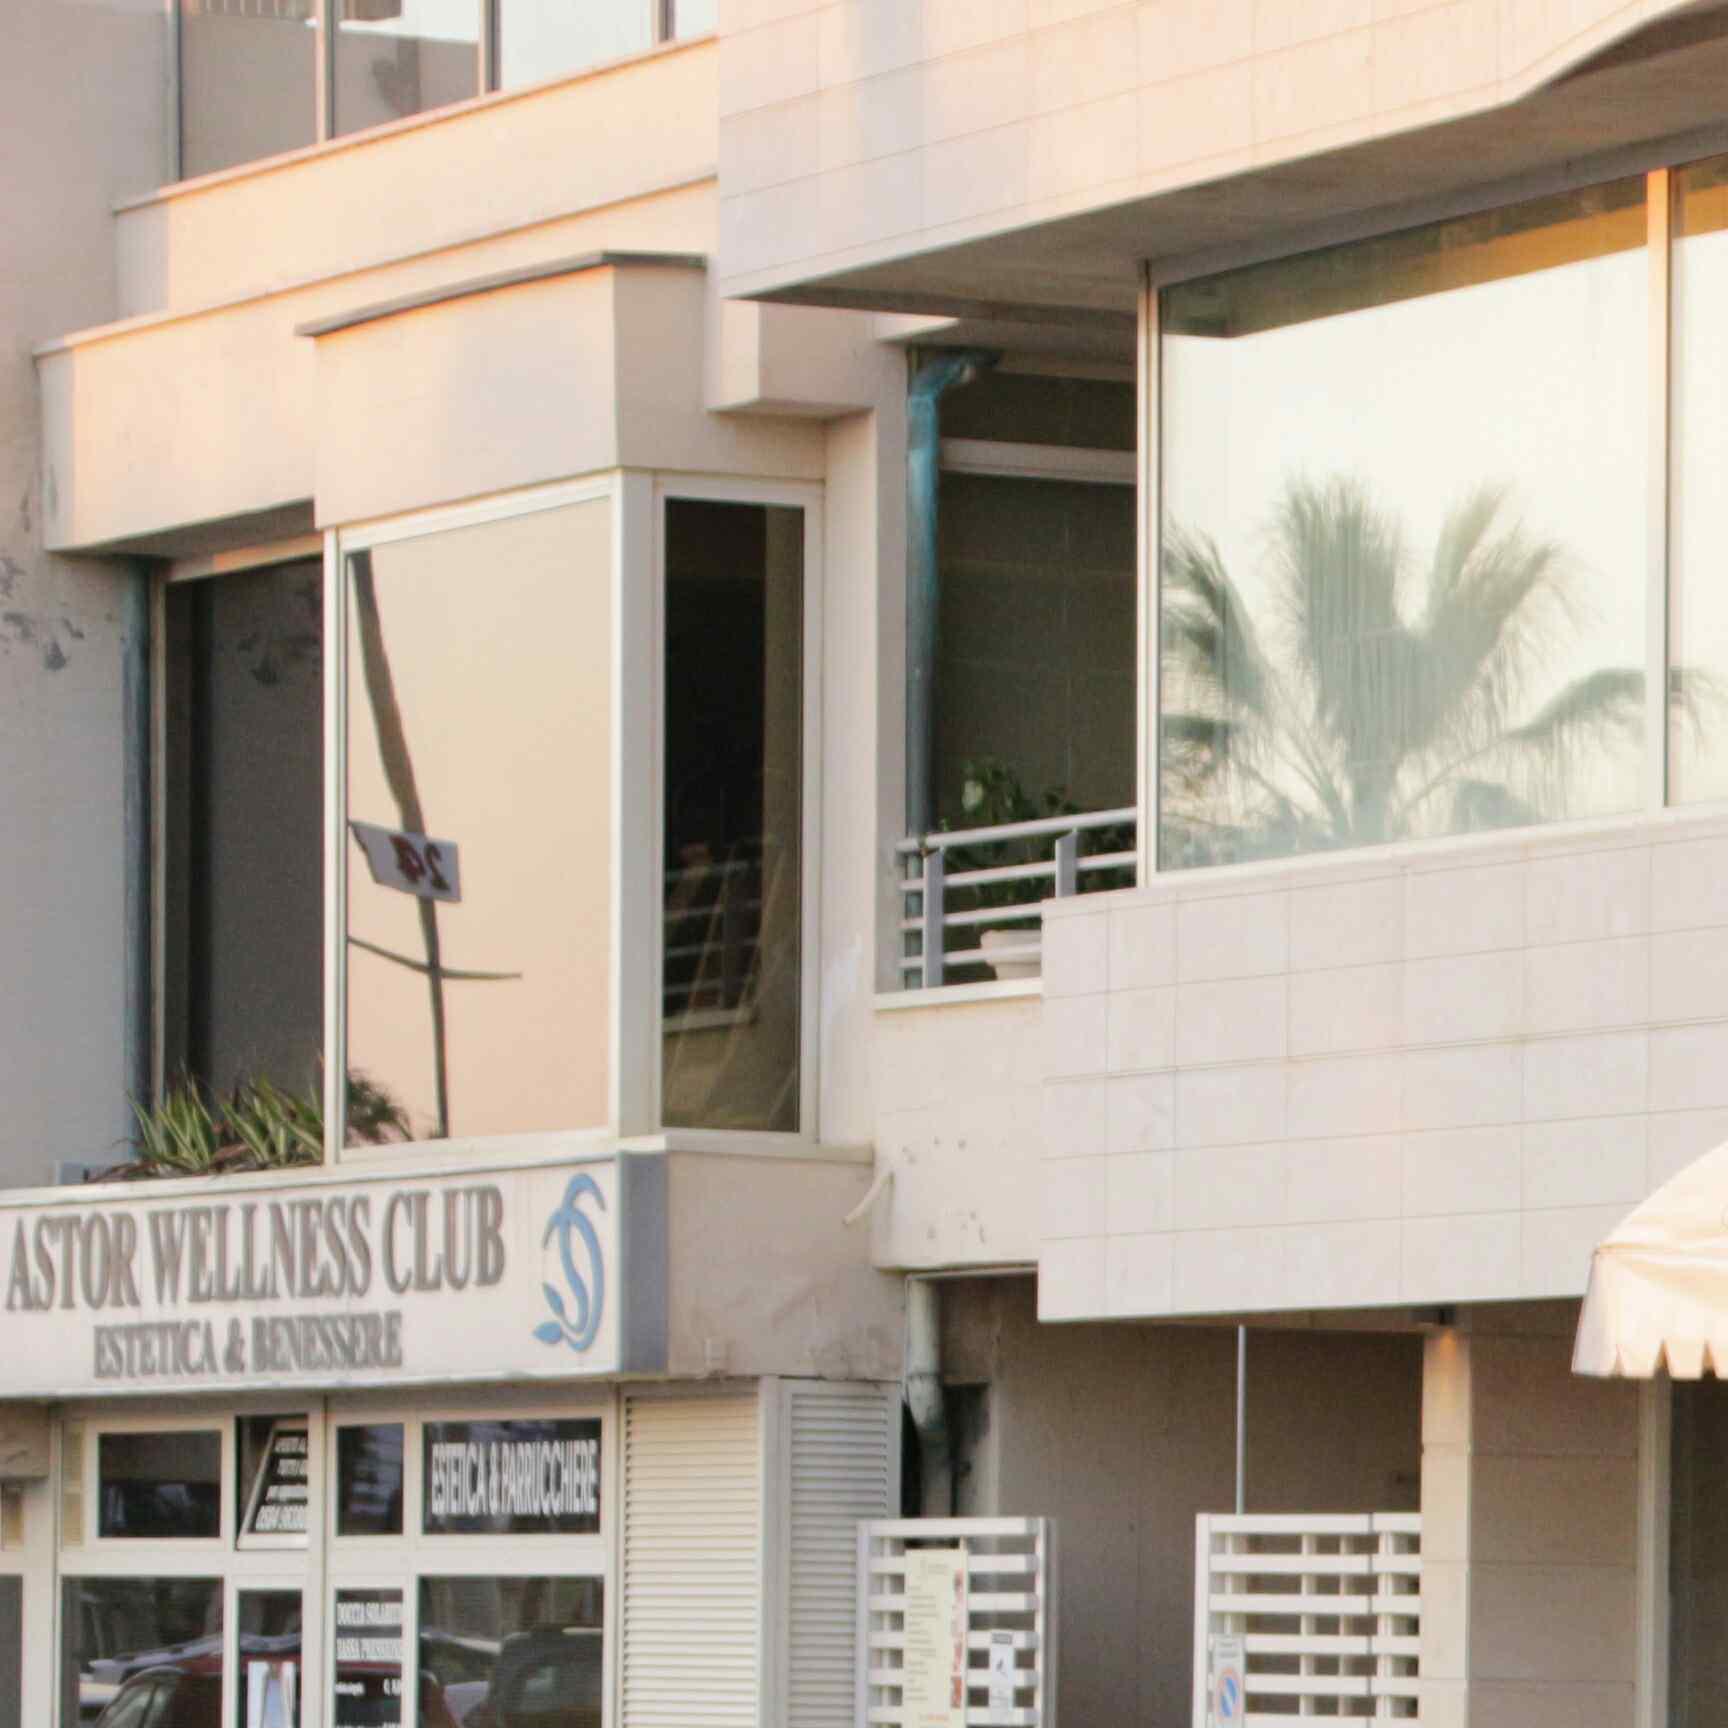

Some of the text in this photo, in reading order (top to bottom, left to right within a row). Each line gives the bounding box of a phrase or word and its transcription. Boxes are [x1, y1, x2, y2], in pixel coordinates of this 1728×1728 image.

[5, 1184, 506, 1311] ASTOR WELLNESS CLUB
[93, 1310, 403, 1379] ESTETICA & BENESSERE
[431, 1438, 598, 1517] ESTETICA & PARRUCCHIERE
